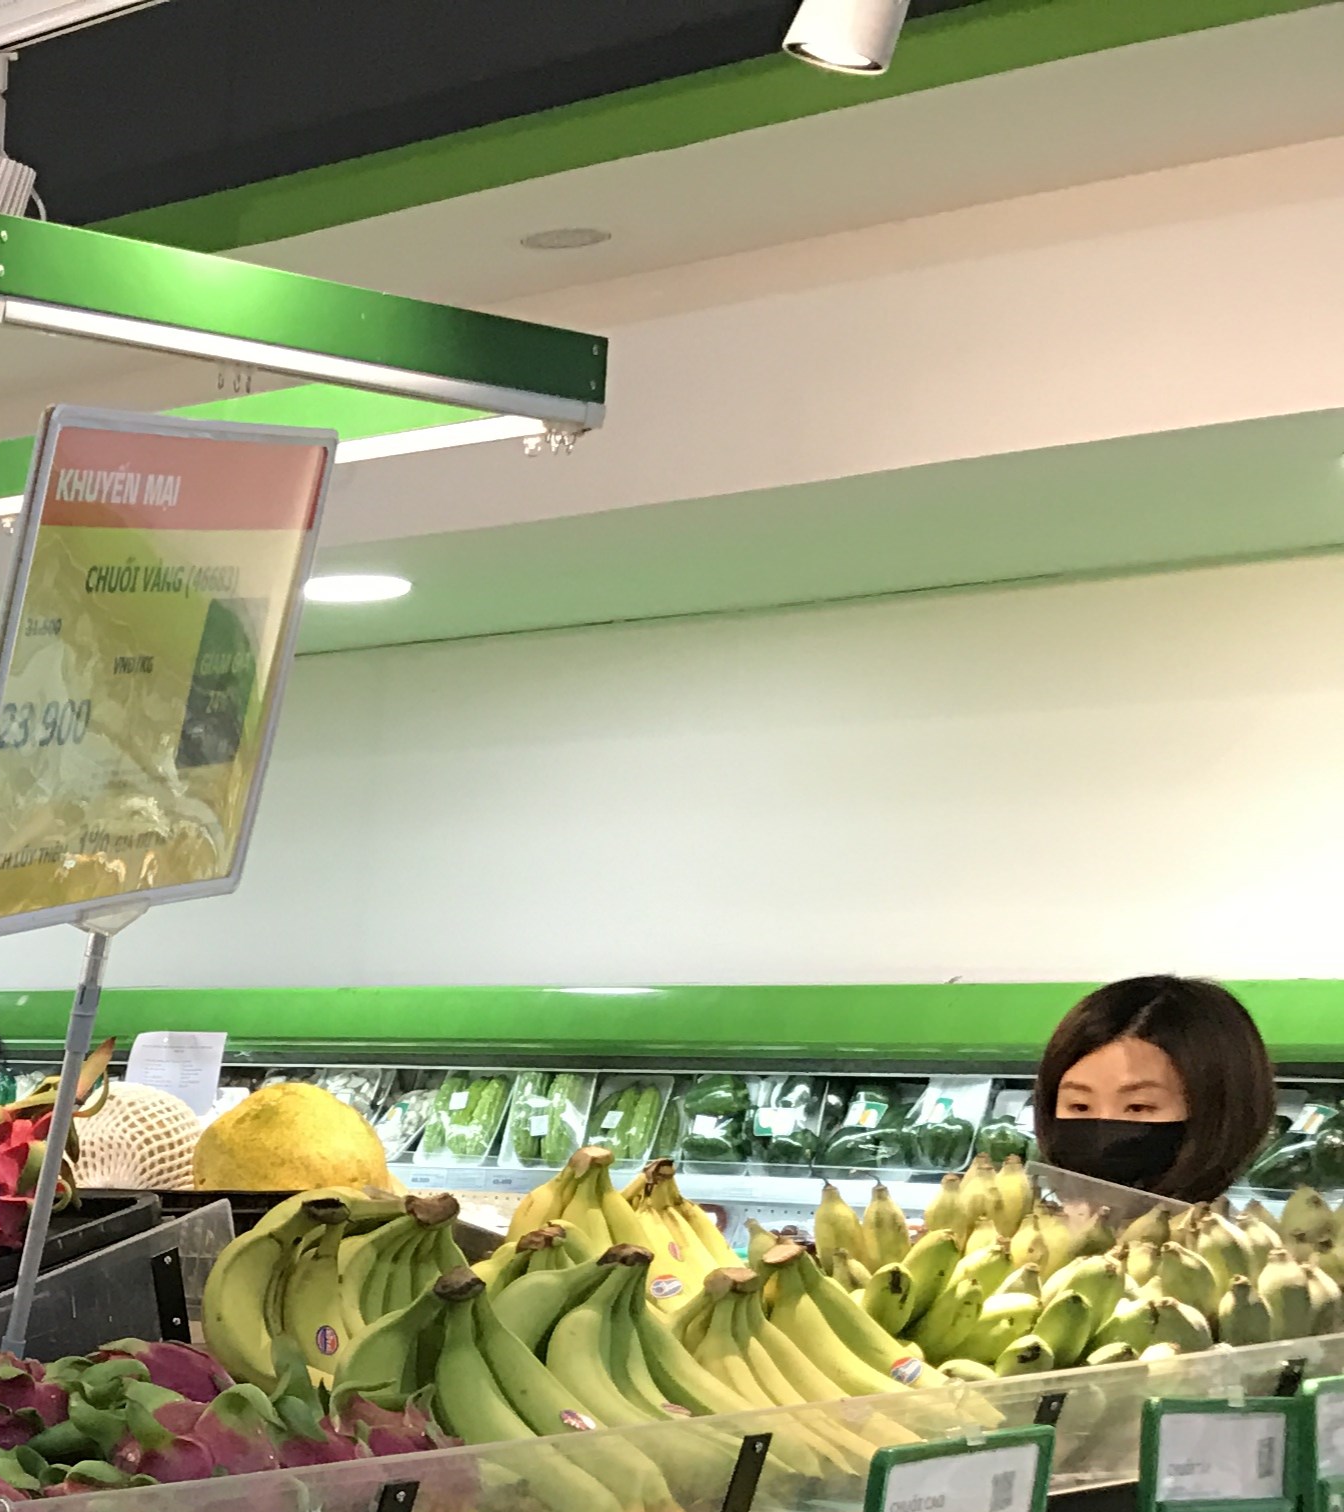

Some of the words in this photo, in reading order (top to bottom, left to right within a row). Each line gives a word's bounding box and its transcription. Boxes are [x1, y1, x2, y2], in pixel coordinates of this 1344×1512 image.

[56, 463, 138, 506] KHUYẾN
[143, 475, 181, 509] MẠI
[85, 560, 139, 594] CHUỐI
